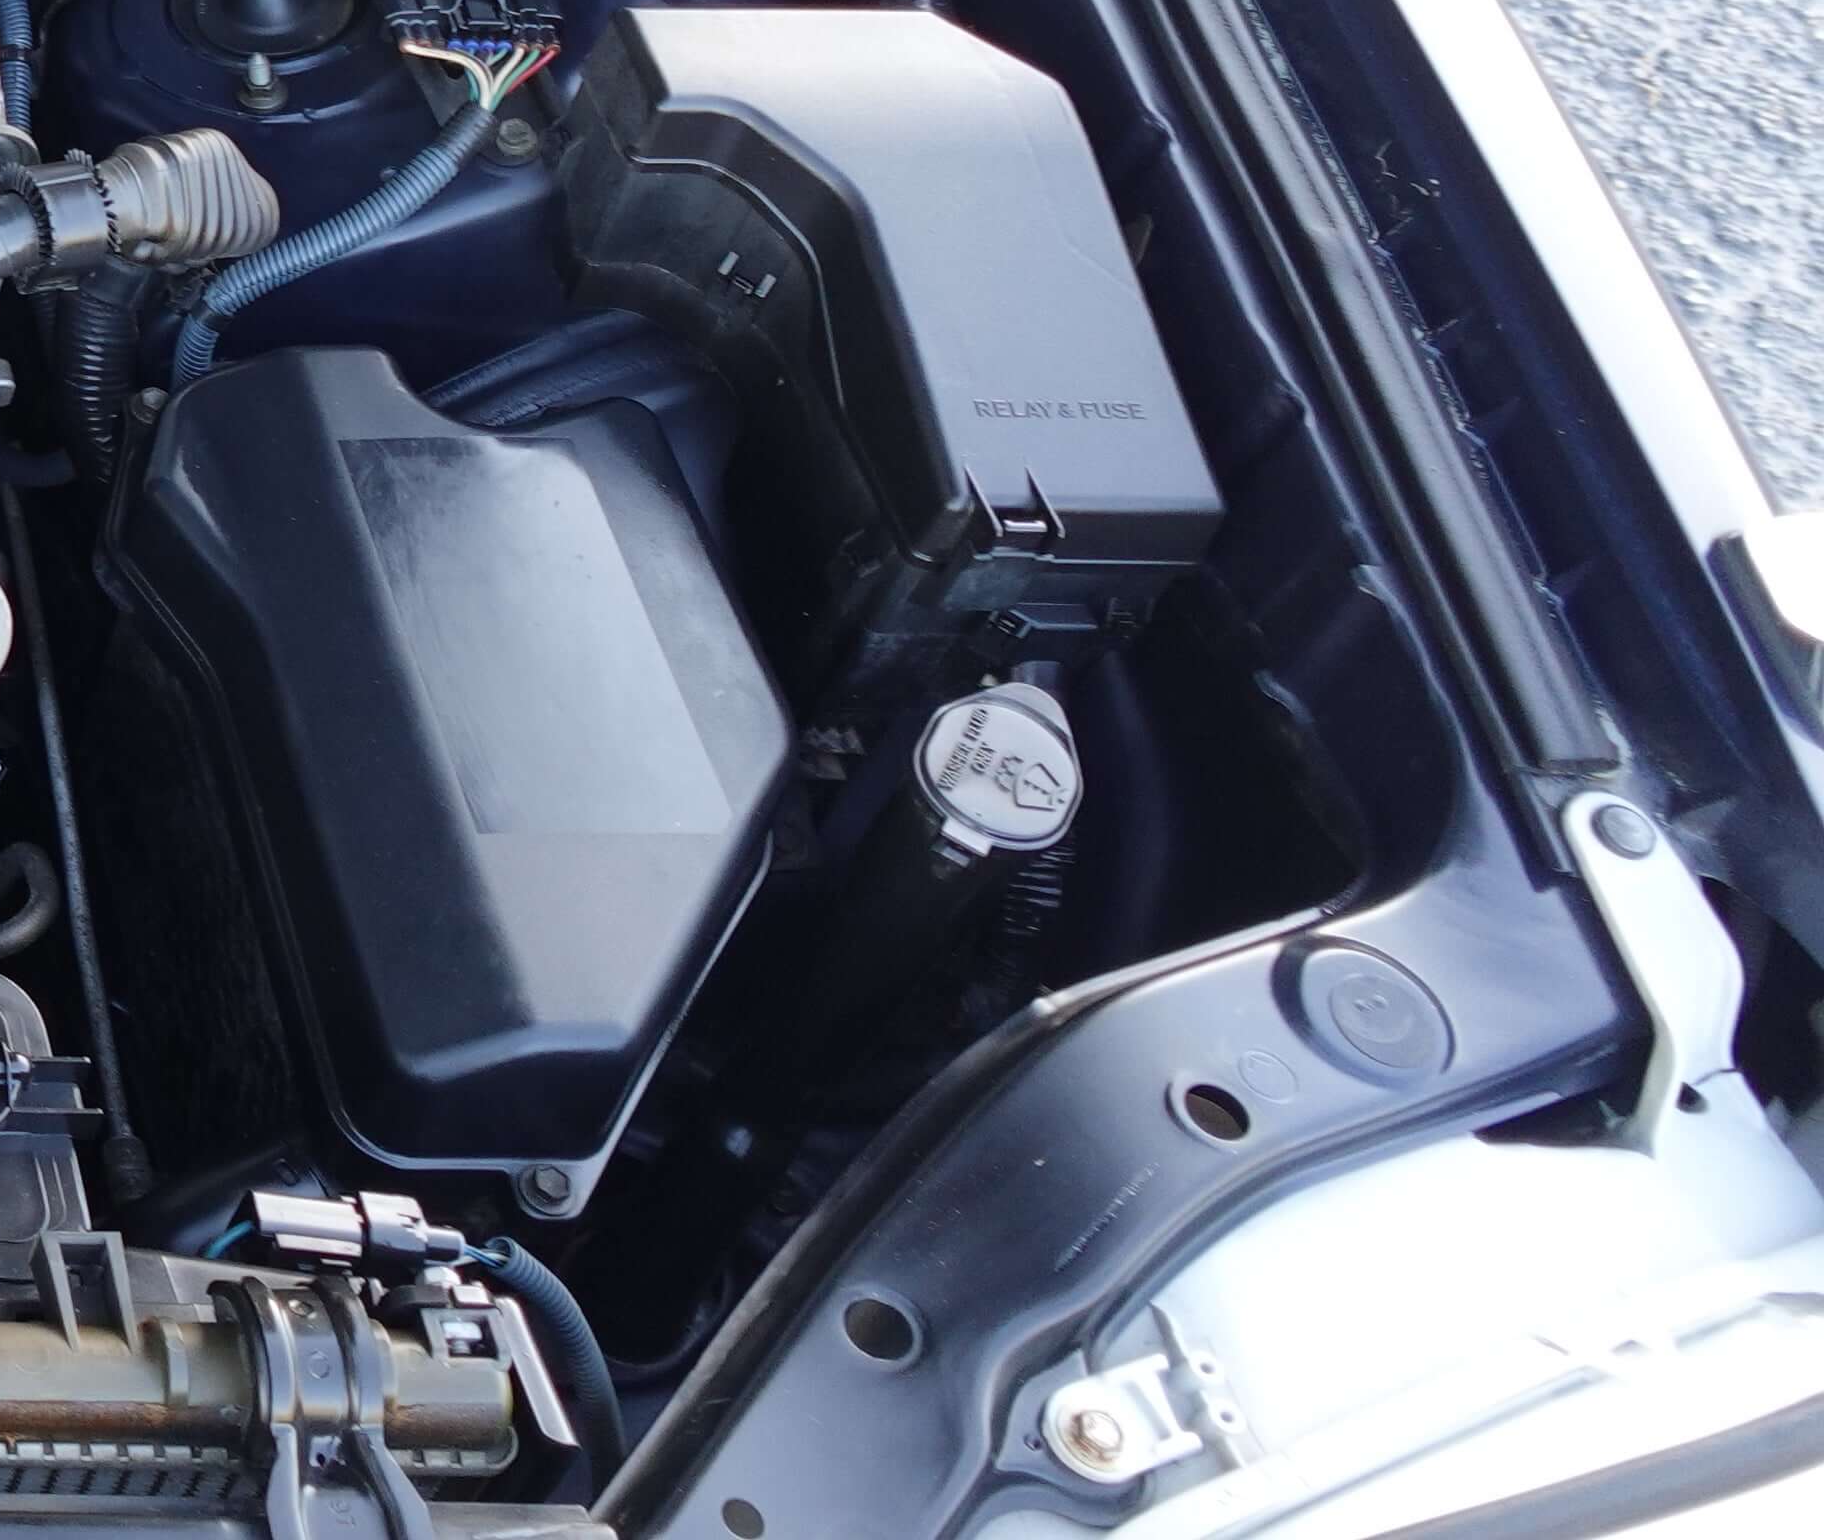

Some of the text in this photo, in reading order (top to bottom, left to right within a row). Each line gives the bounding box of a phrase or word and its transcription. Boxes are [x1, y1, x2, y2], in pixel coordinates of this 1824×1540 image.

[972, 398, 1147, 420] RELAY & FUSE
